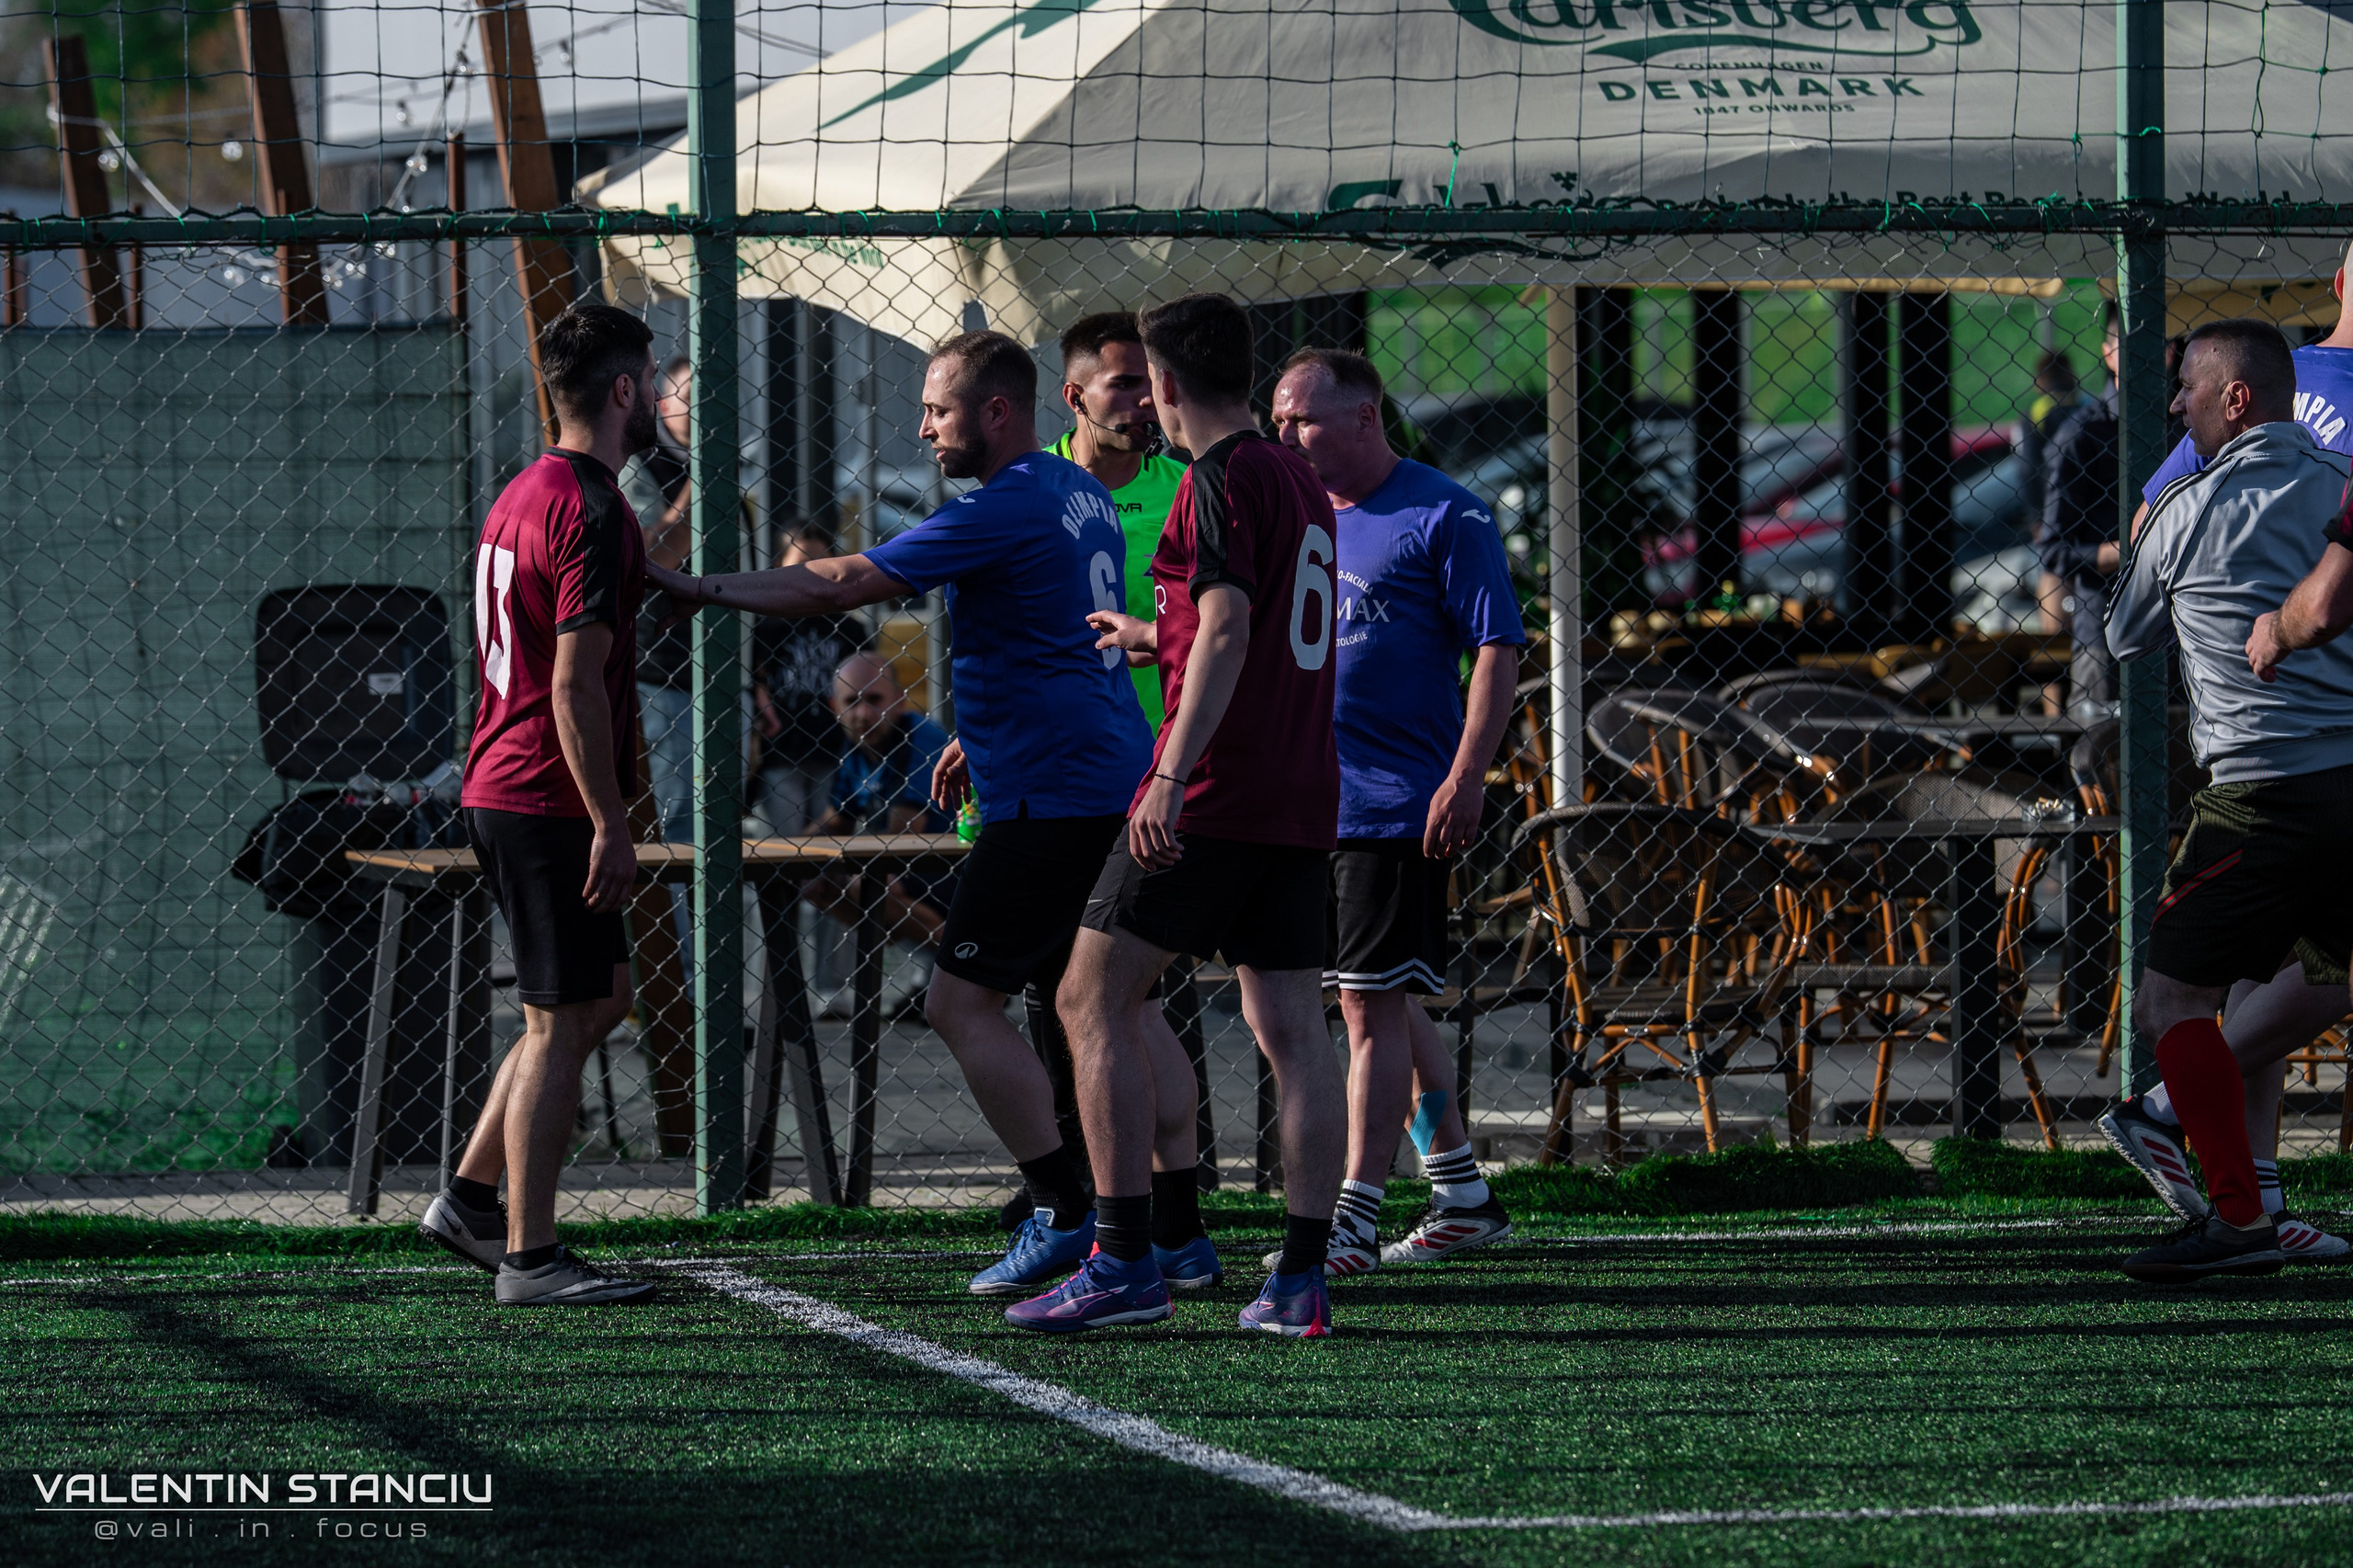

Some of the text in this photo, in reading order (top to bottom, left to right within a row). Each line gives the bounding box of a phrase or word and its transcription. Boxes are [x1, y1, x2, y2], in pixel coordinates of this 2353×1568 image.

[1597, 77, 1925, 102] DENMARK
[1748, 103, 1856, 113] ONWARDS
[1062, 491, 1119, 540] OLIMPIA
[1089, 551, 1121, 670] 6
[1289, 524, 1334, 671] 6
